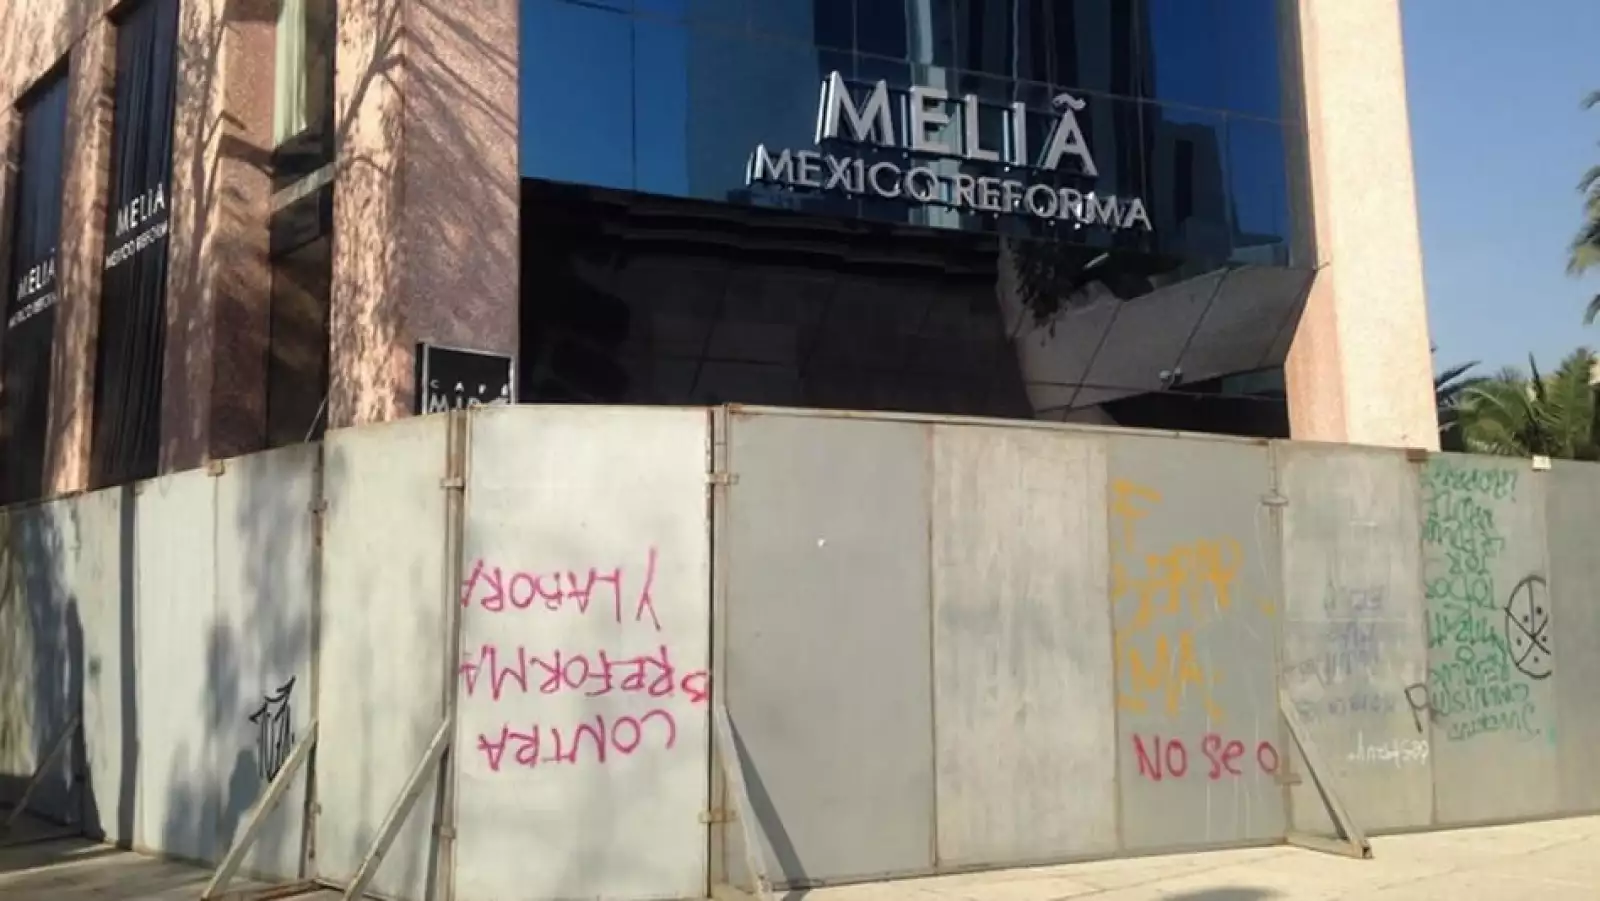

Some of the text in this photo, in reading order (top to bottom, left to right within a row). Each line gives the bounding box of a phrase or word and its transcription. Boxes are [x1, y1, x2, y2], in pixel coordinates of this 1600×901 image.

[746, 143, 1152, 231] MEXICO REFORMA
[636, 548, 660, 631] Y
[460, 644, 675, 701] REFORMA
[477, 709, 676, 772] CONTRA
[1132, 733, 1187, 782] NO
